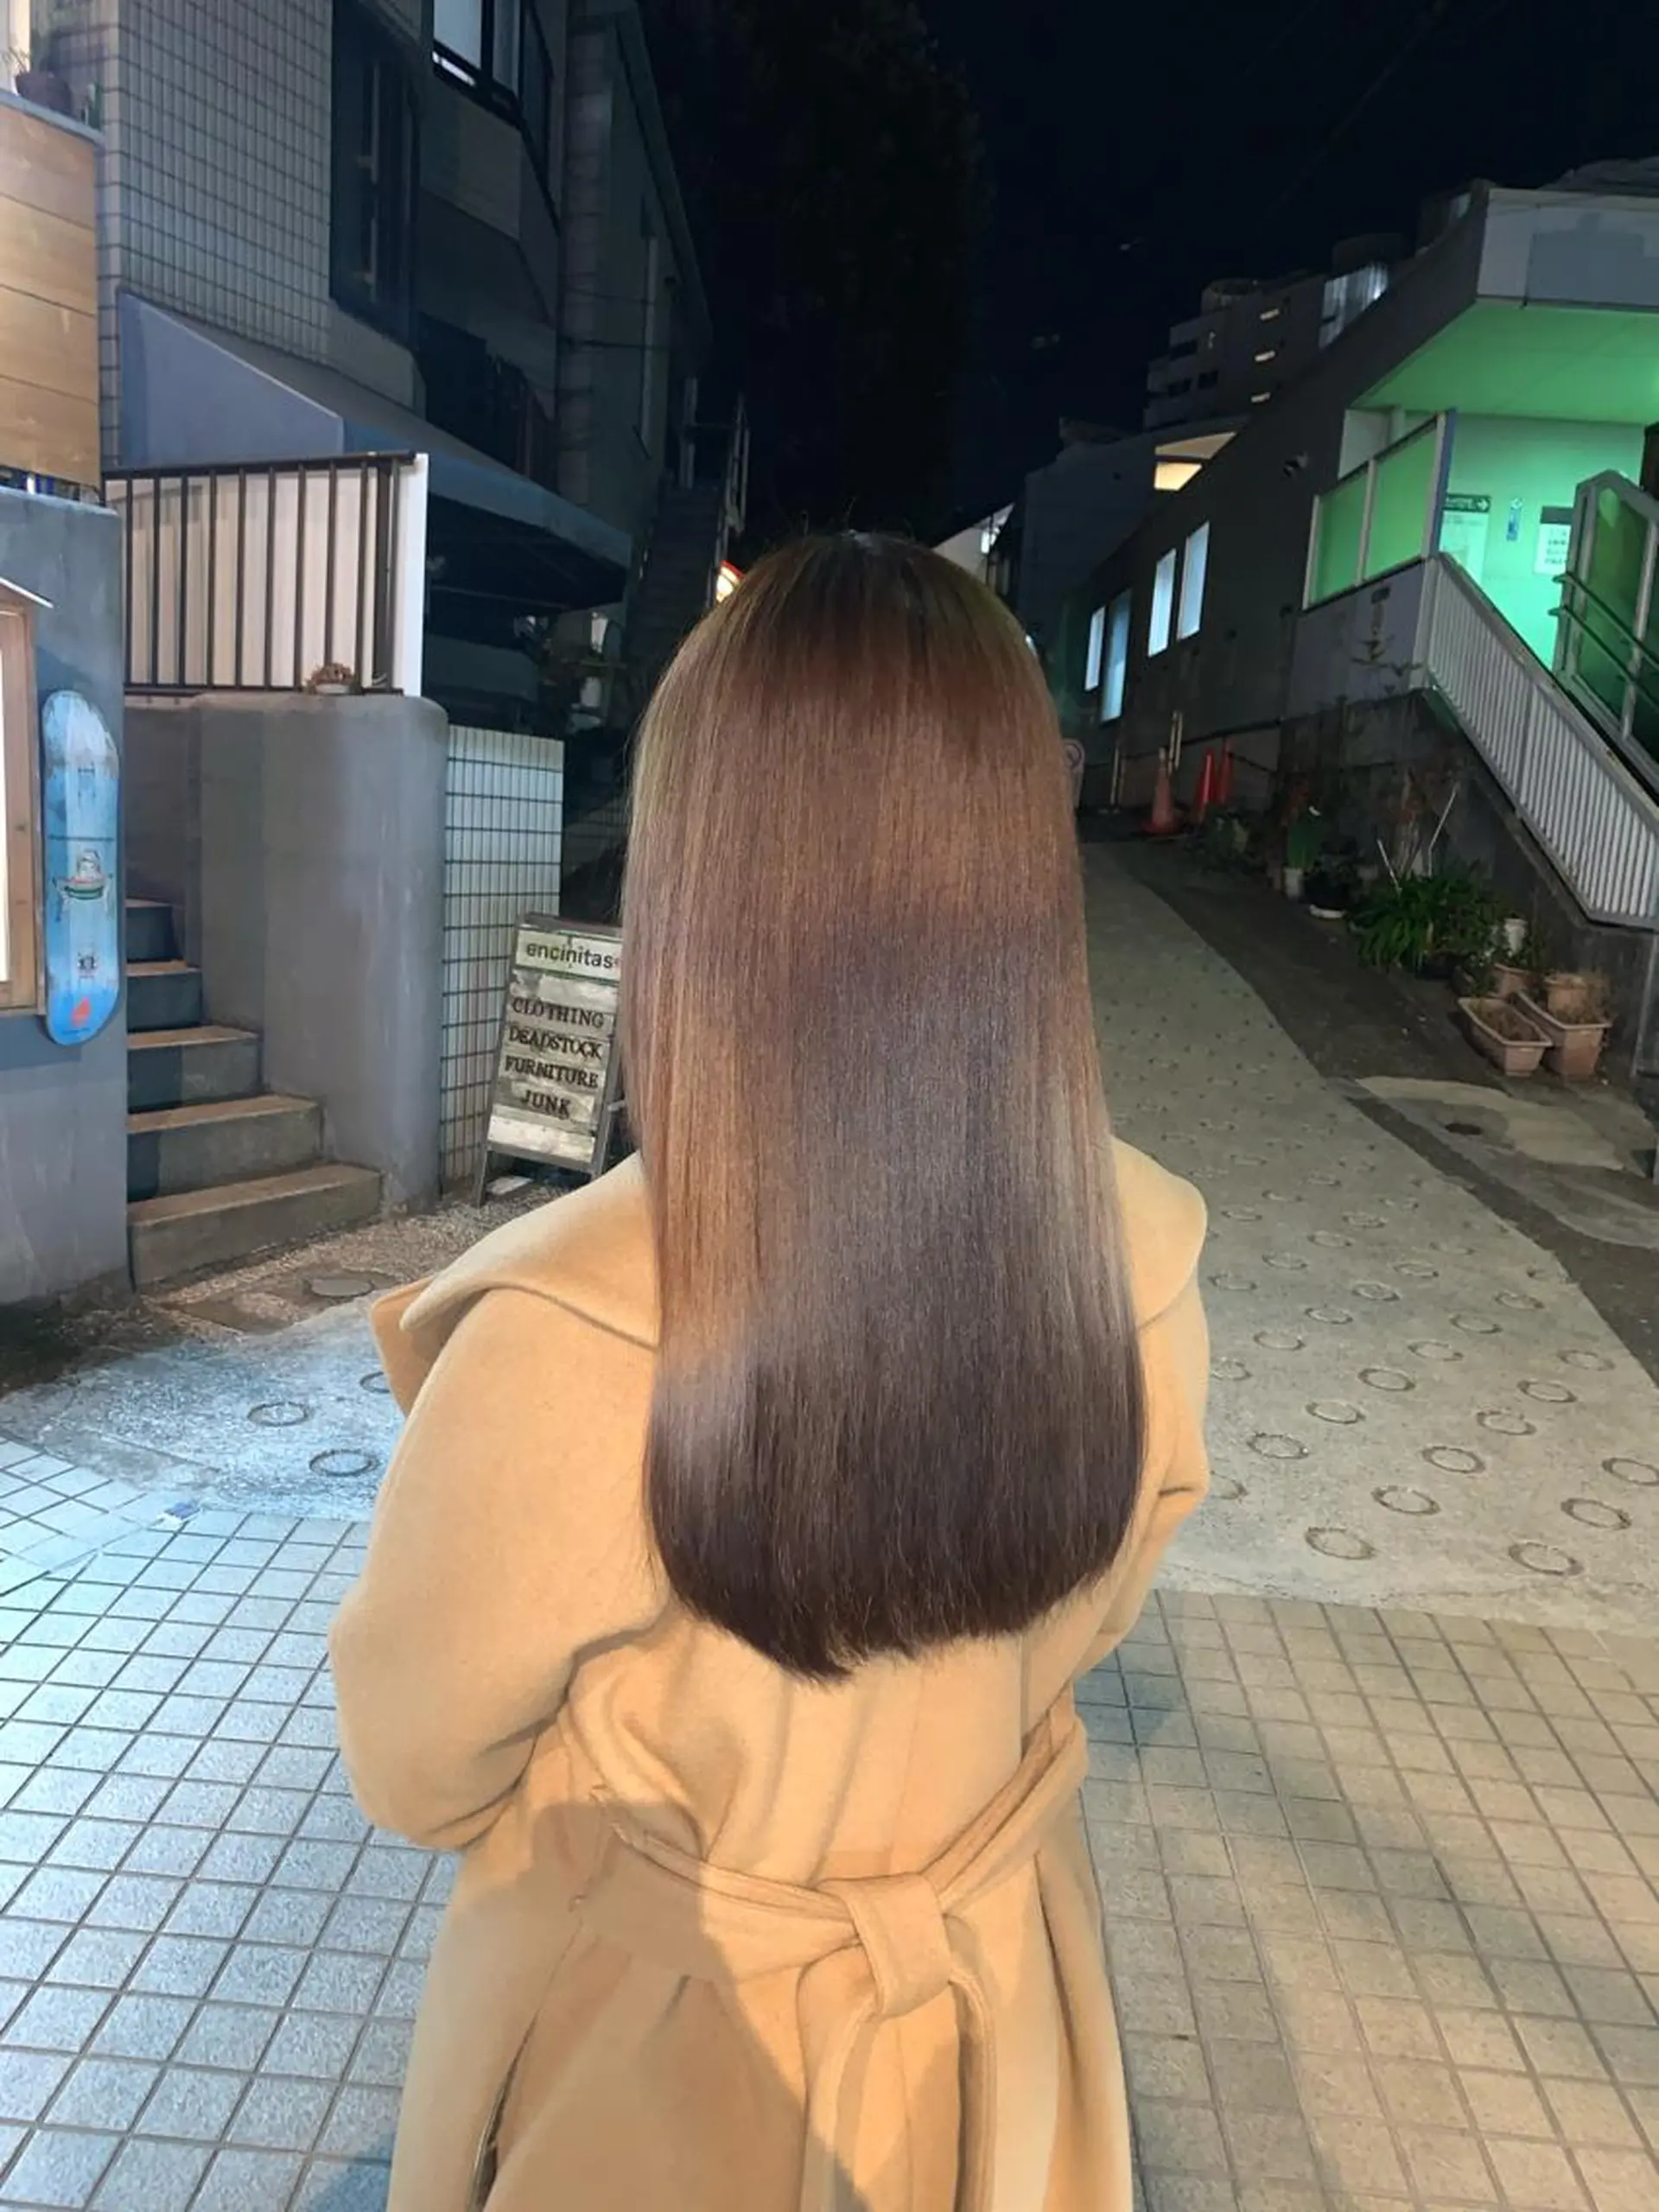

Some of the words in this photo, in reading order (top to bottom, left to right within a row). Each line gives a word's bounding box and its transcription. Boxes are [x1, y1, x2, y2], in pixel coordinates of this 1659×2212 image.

[512, 997, 604, 1028] CLOTHING
[509, 1027, 602, 1059] DEADSTOCK
[505, 1055, 599, 1089] FURNITURE
[521, 1089, 570, 1121] JUNK
